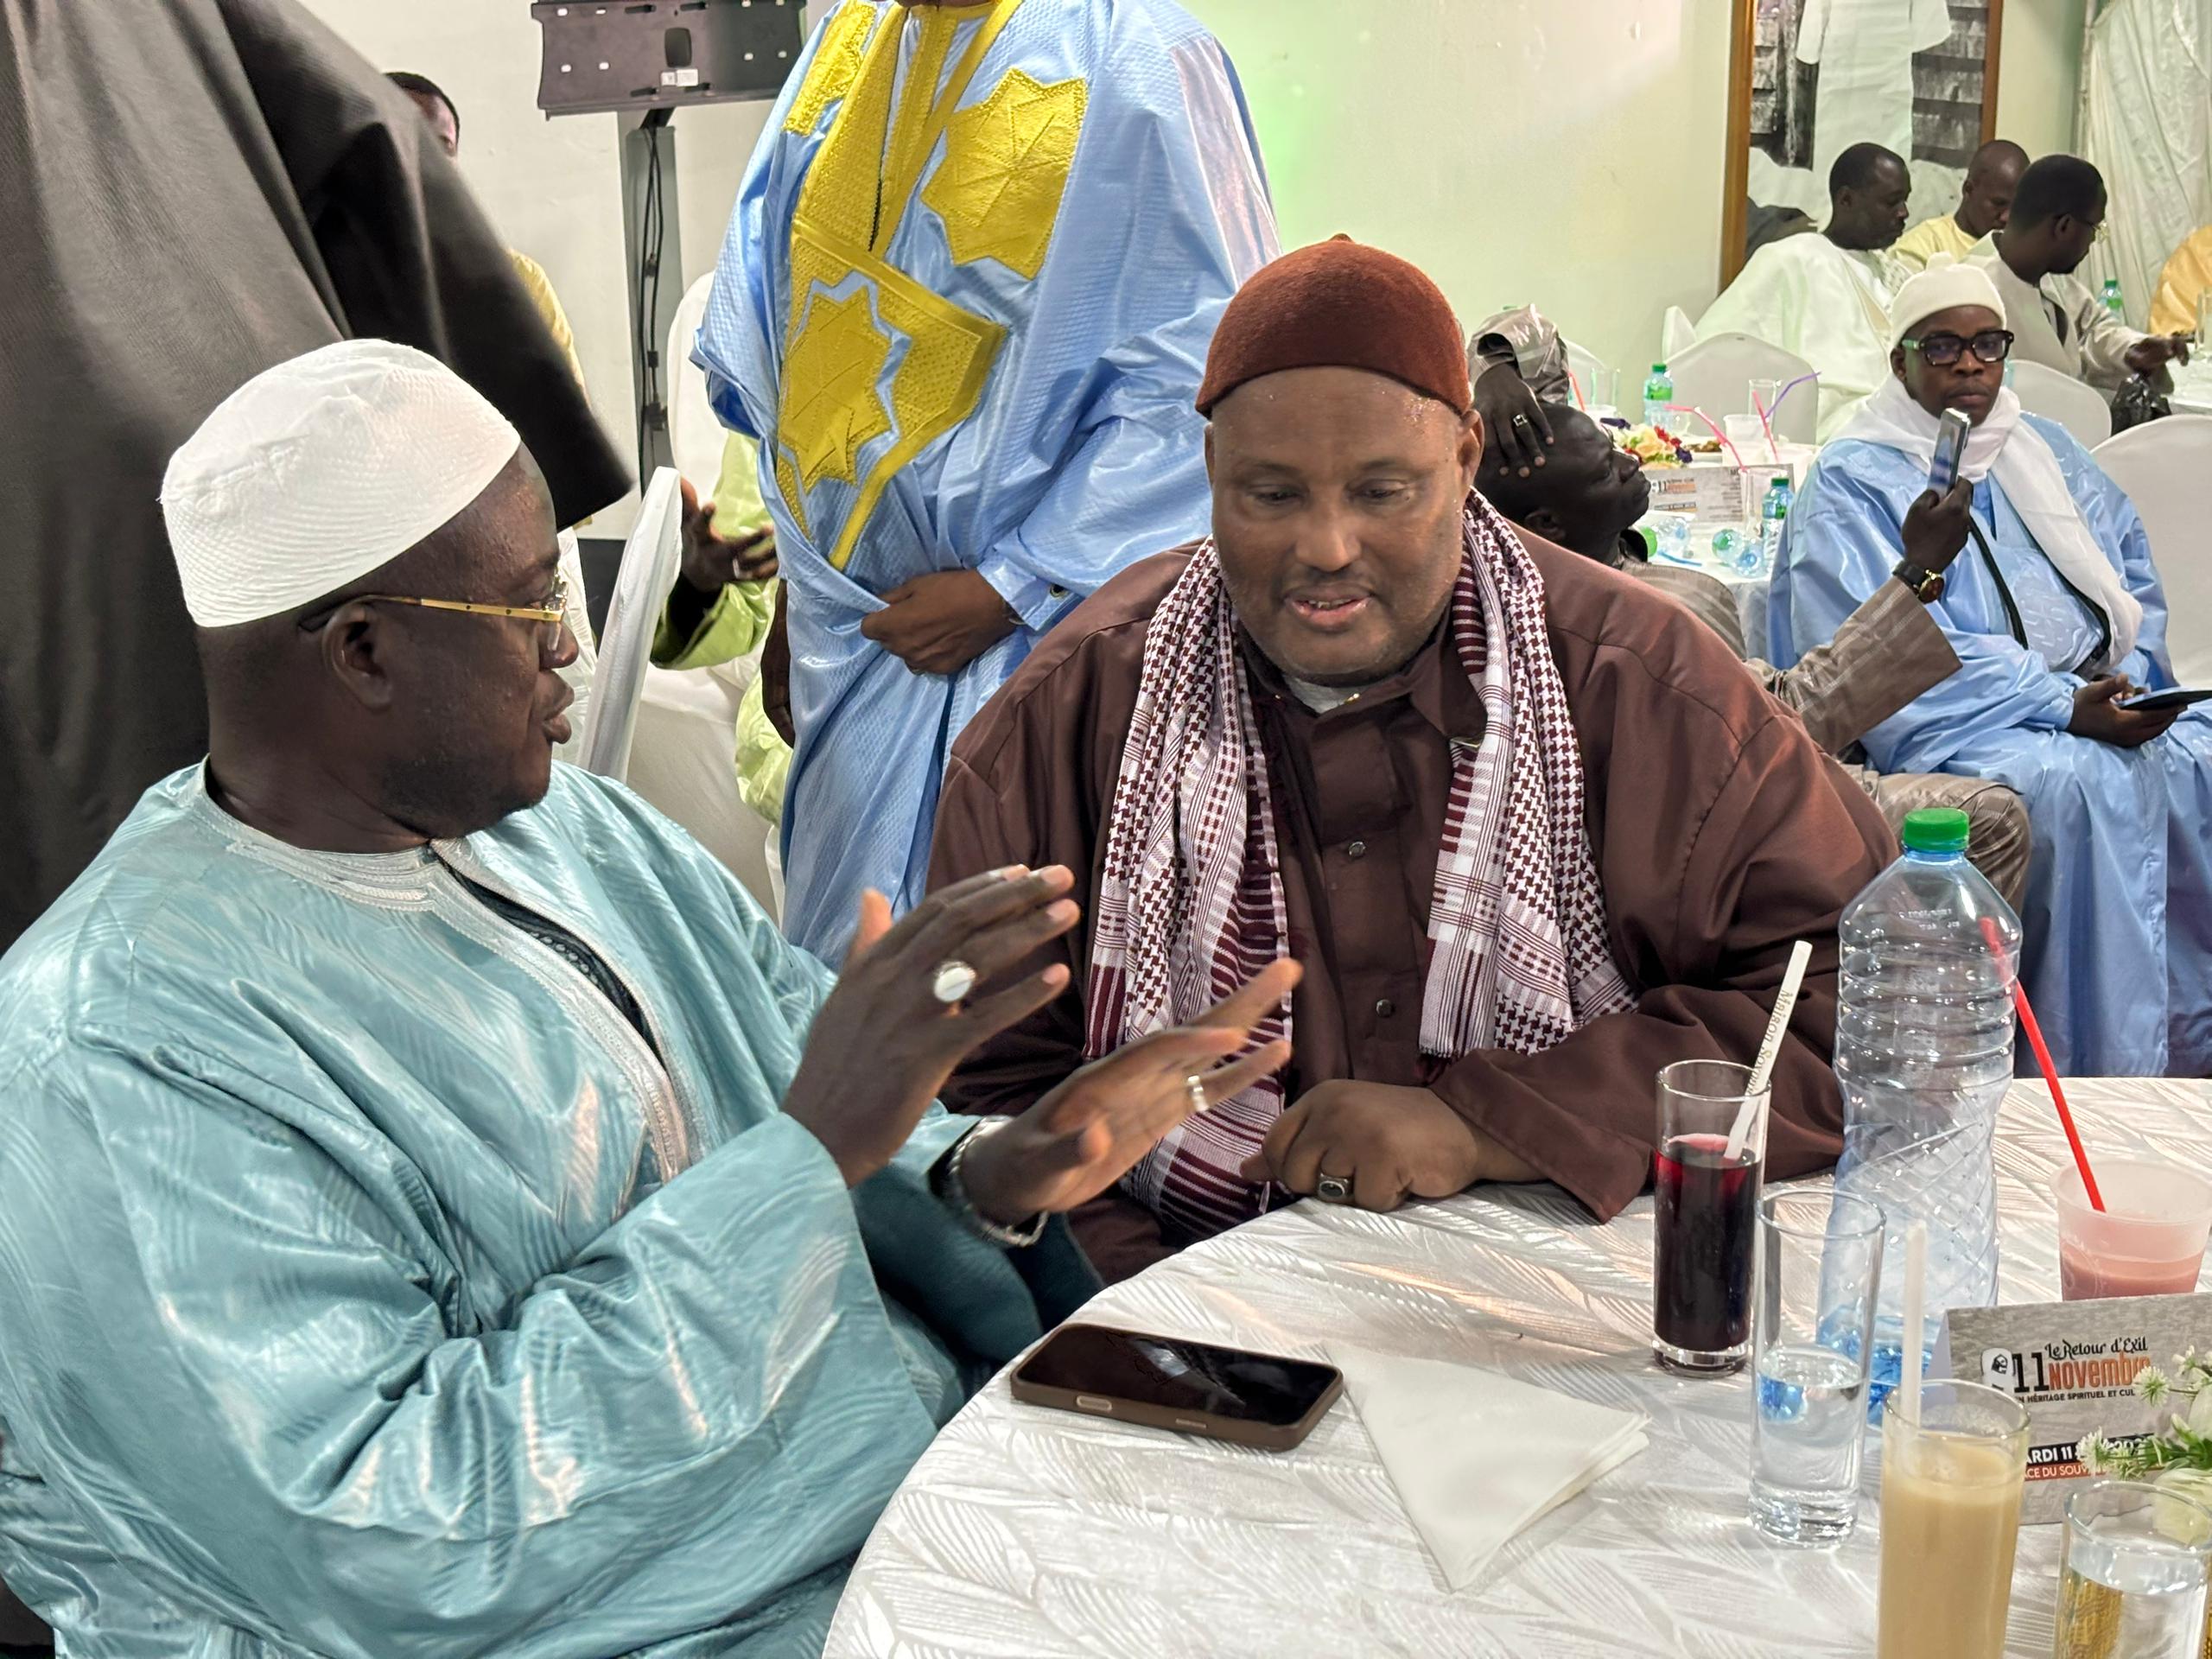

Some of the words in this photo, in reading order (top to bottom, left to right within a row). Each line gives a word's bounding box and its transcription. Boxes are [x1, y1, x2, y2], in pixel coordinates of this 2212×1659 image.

[2044, 1342, 2066, 1360] Le
[2062, 1339, 2107, 1360] Retour
[2012, 1351, 2050, 1393] 11
[2027, 1393, 2065, 1403] HÉRITAGE
[2068, 1390, 2106, 1400] SPIRITUEL
[2108, 1389, 2117, 1398] ET
[2061, 1446, 2073, 1460] 11
[2043, 1466, 2057, 1478] DU
[2059, 1461, 2089, 1476] SOUV
